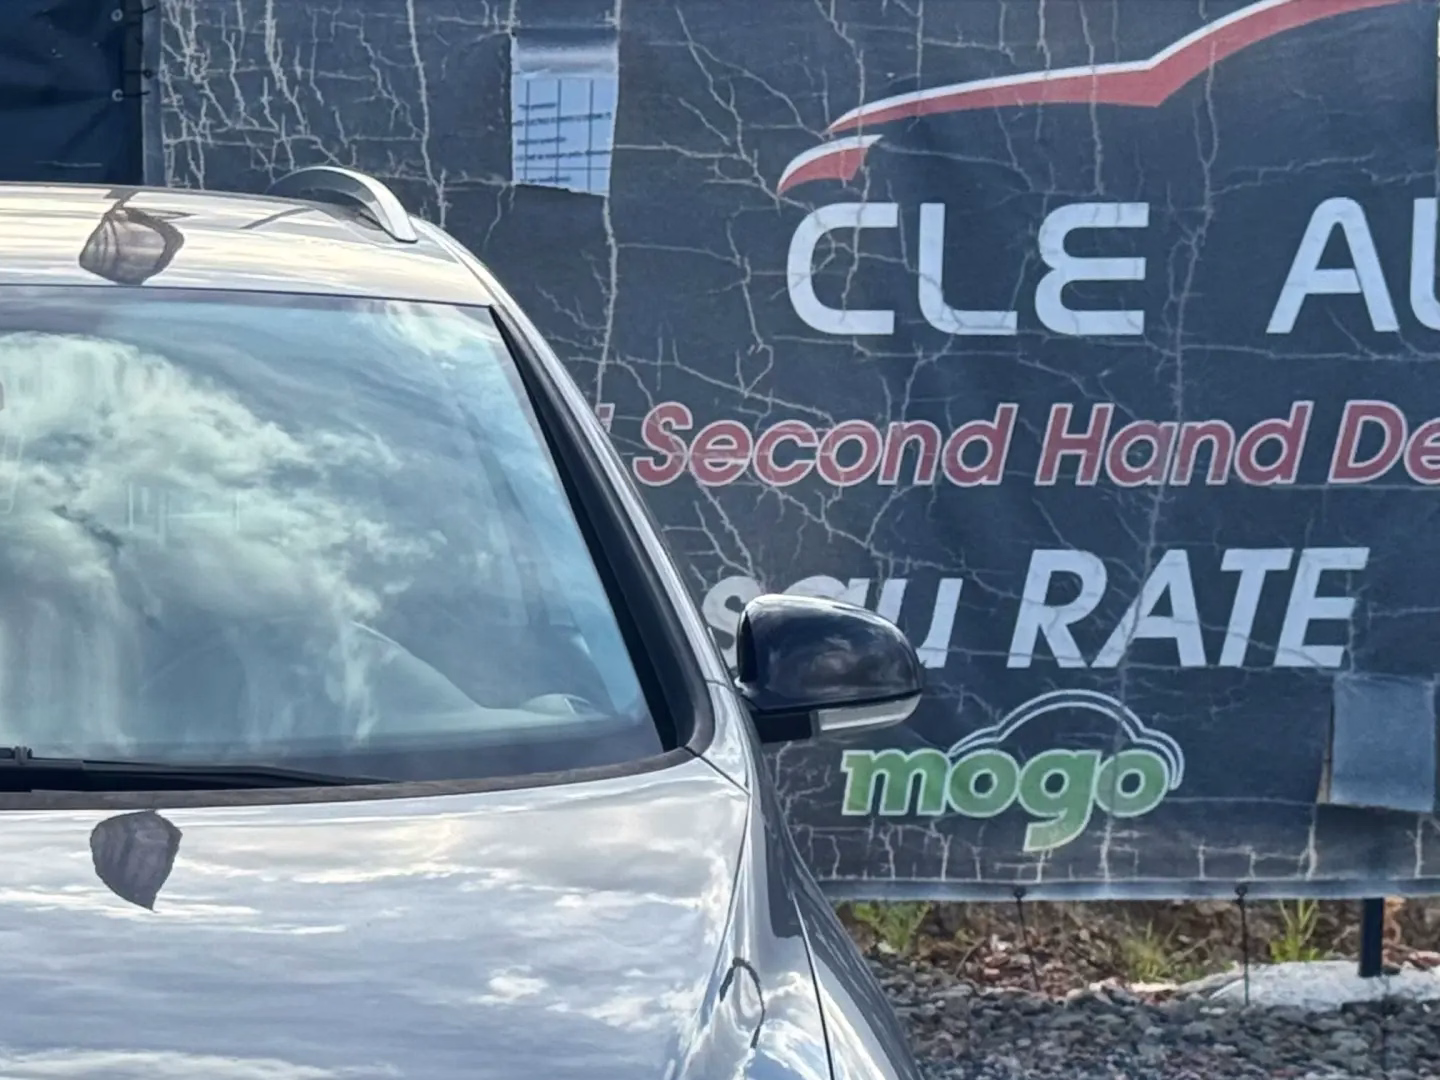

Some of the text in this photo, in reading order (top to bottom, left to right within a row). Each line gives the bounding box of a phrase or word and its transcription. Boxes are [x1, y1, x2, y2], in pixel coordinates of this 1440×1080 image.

[787, 201, 1150, 336] CLE
[632, 401, 1019, 487] Second
[1035, 400, 1314, 486] Hand
[1006, 546, 1370, 669] RATE
[839, 748, 1168, 853] mogo
